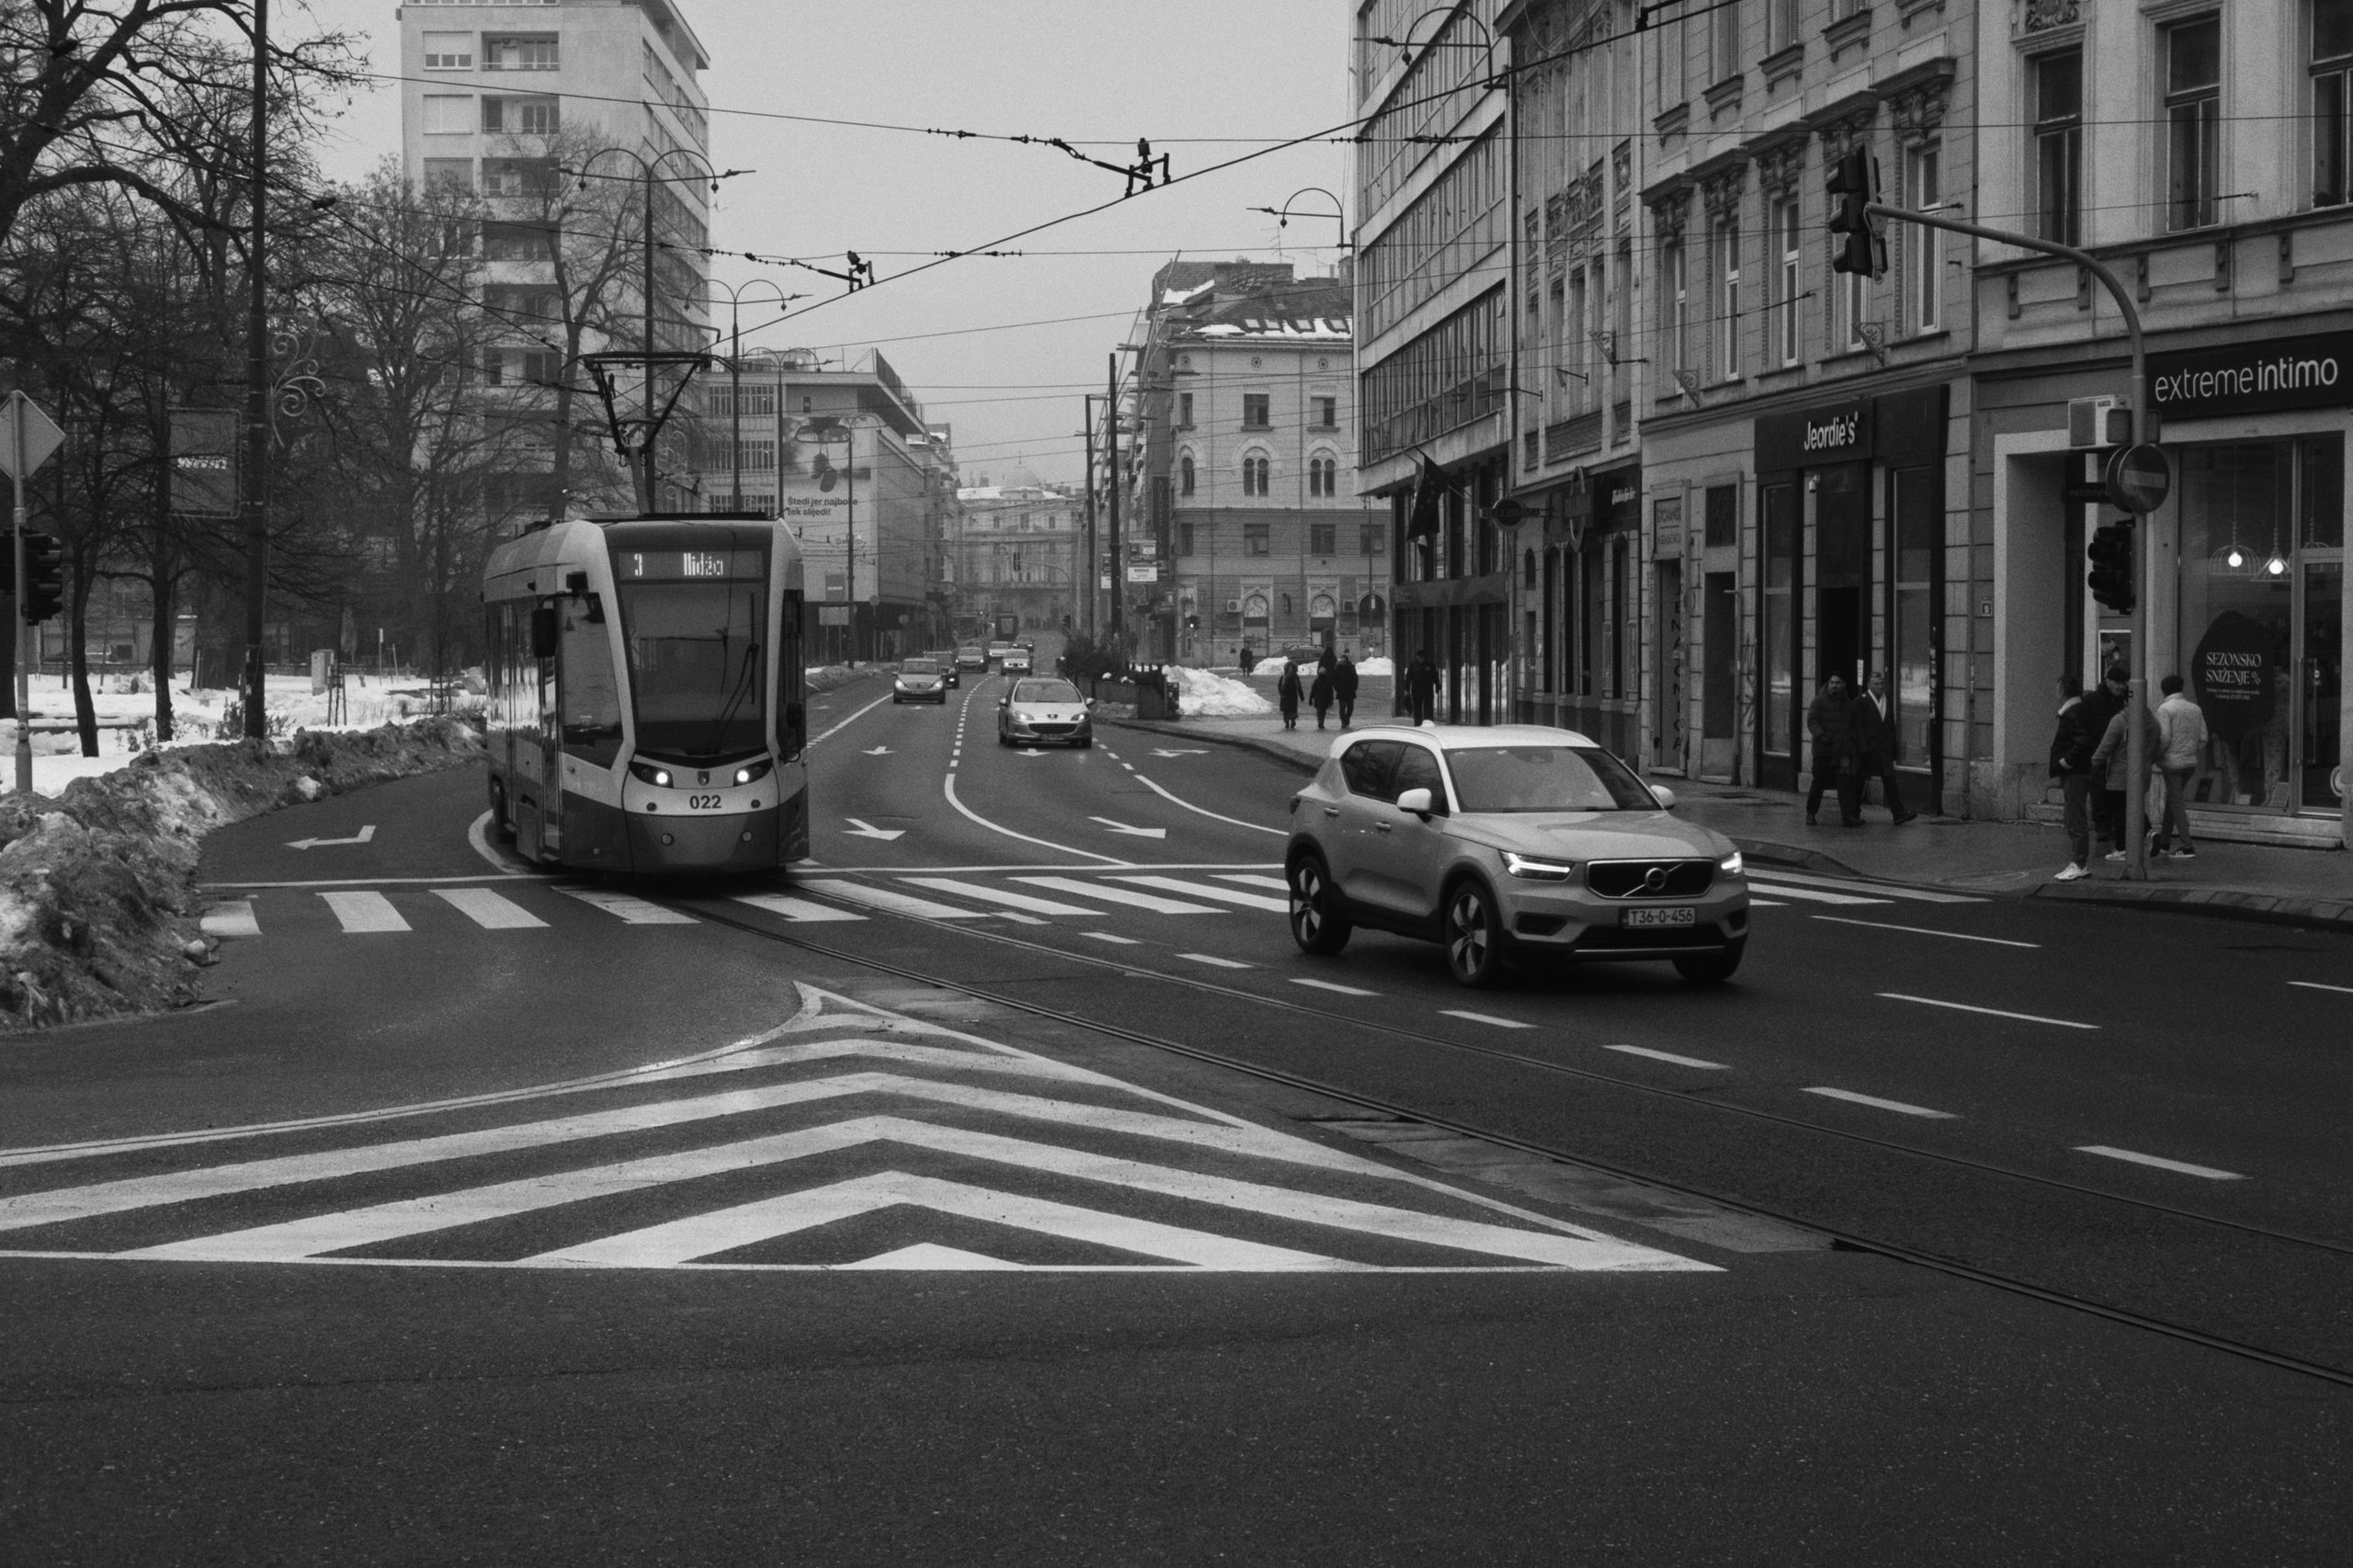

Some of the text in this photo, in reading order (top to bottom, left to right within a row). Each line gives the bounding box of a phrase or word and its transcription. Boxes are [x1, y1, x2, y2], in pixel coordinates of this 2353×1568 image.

[2155, 357, 2338, 402] extreme intimo
[1803, 414, 1856, 450] Jeordie's
[824, 497, 858, 507] najboe
[634, 552, 643, 576] 3
[2206, 653, 2262, 667] SEZONSKO
[2206, 668, 2261, 686] SNIŽENJE %
[689, 795, 722, 810] 022
